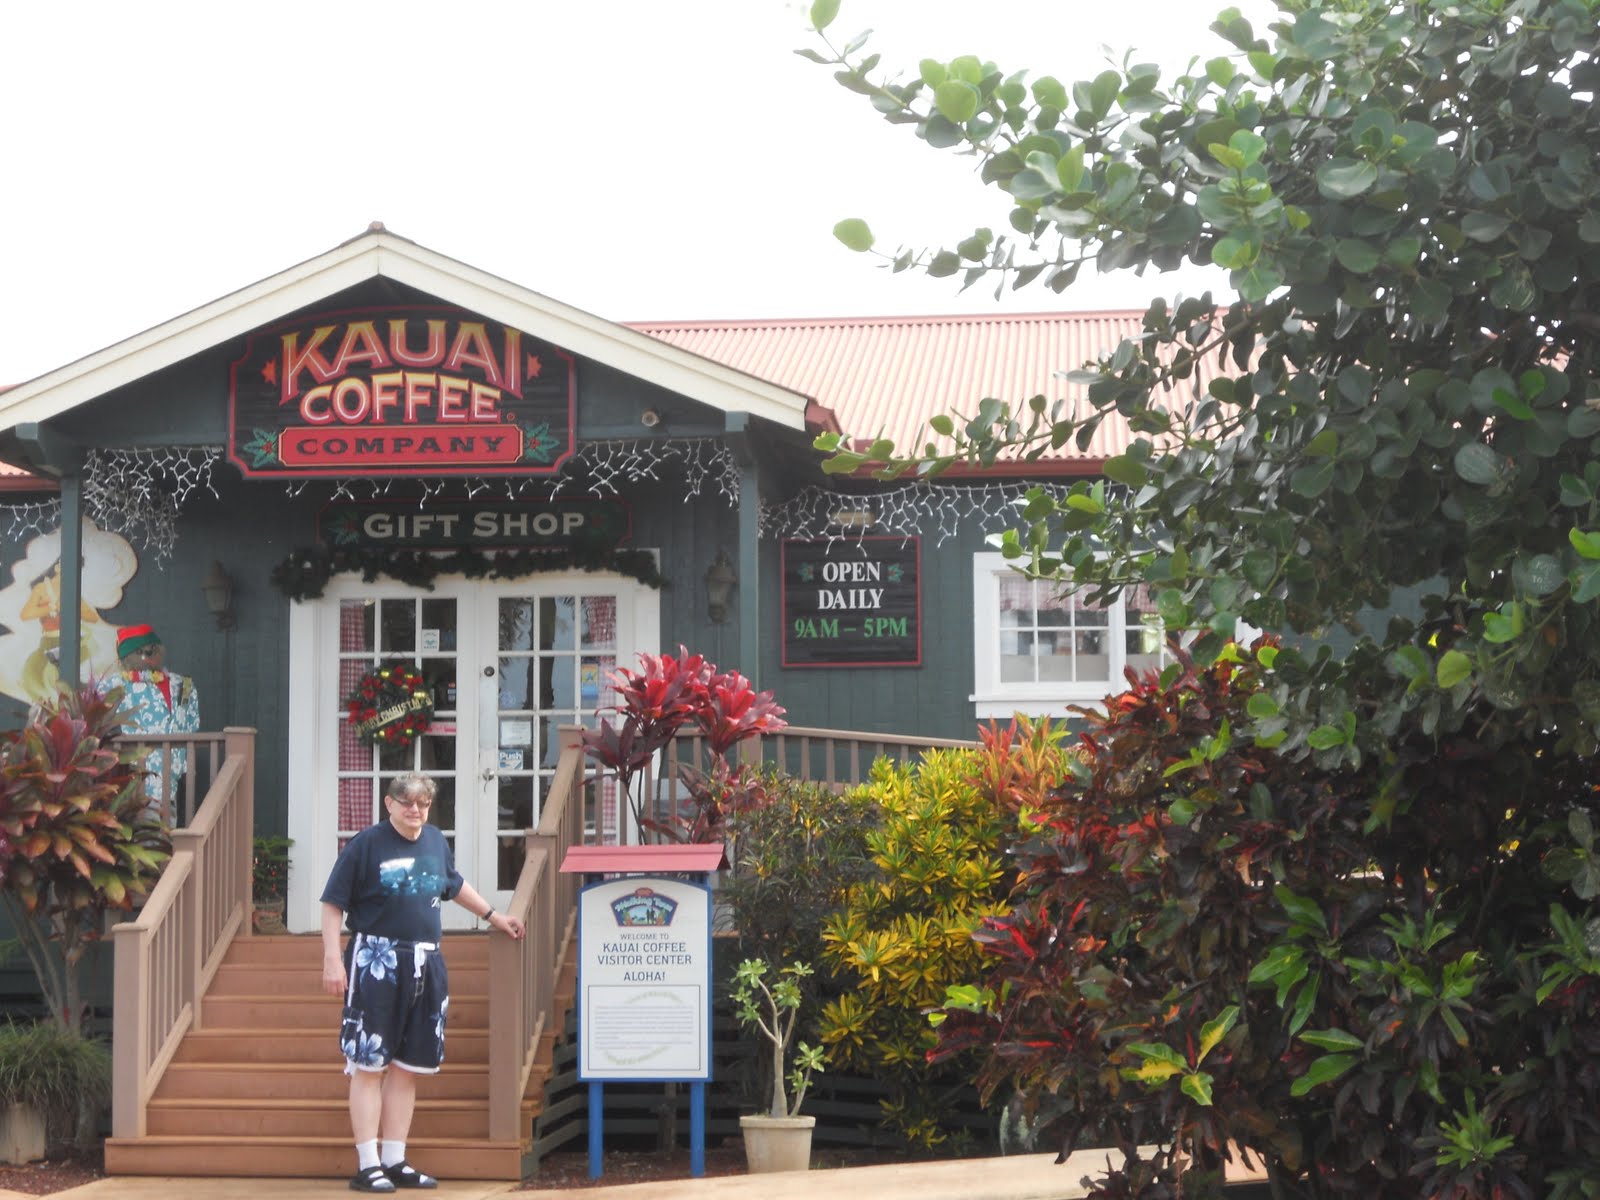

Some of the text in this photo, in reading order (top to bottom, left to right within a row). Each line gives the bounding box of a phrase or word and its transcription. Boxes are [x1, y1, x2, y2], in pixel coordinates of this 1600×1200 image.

[279, 319, 523, 407] KAUAI
[300, 370, 502, 425] COFFEE
[296, 436, 508, 455] COMPANY
[363, 512, 585, 538] GIFT SHOP
[822, 562, 881, 582] OPEN
[817, 589, 884, 609] DAILY
[795, 618, 839, 638] 9AM
[863, 617, 908, 638] 5PM
[500, 751, 522, 761] Push
[603, 942, 687, 953] KAUAI COFFEE
[598, 955, 692, 965] VISITOR CENTER
[624, 971, 665, 981] ALOHA!
